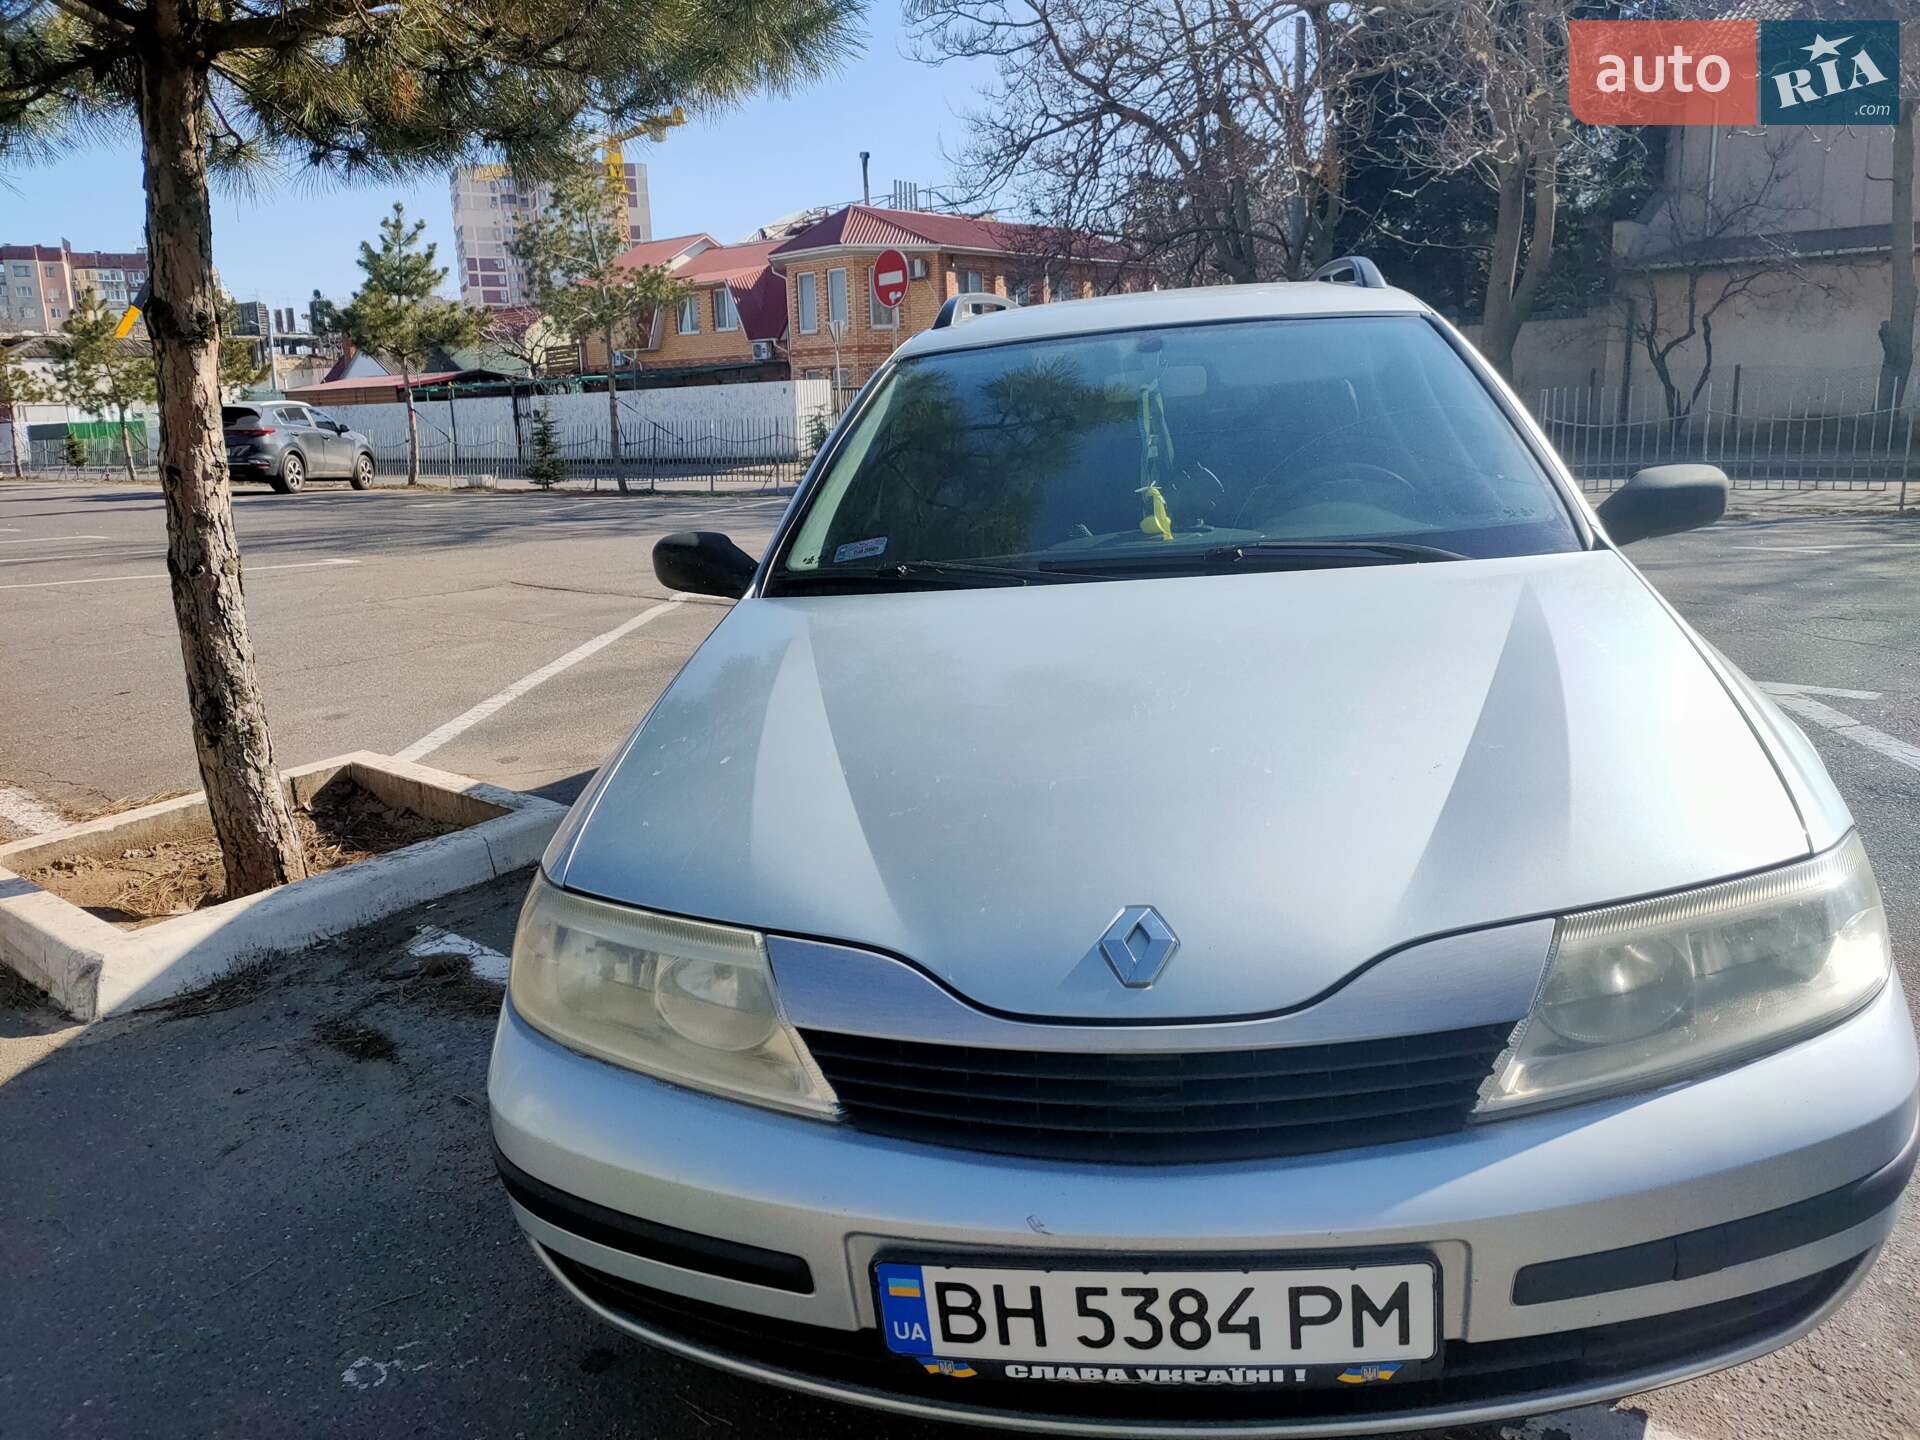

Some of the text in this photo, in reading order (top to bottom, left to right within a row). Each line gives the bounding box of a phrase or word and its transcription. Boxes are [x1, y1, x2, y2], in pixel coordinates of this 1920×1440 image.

[934, 1281, 1410, 1351] BH 5384 PM
[893, 1321, 927, 1342] UA
[1004, 1364, 1129, 1382] СЛАВА
[1135, 1367, 1284, 1384] УКРАЇНІ
